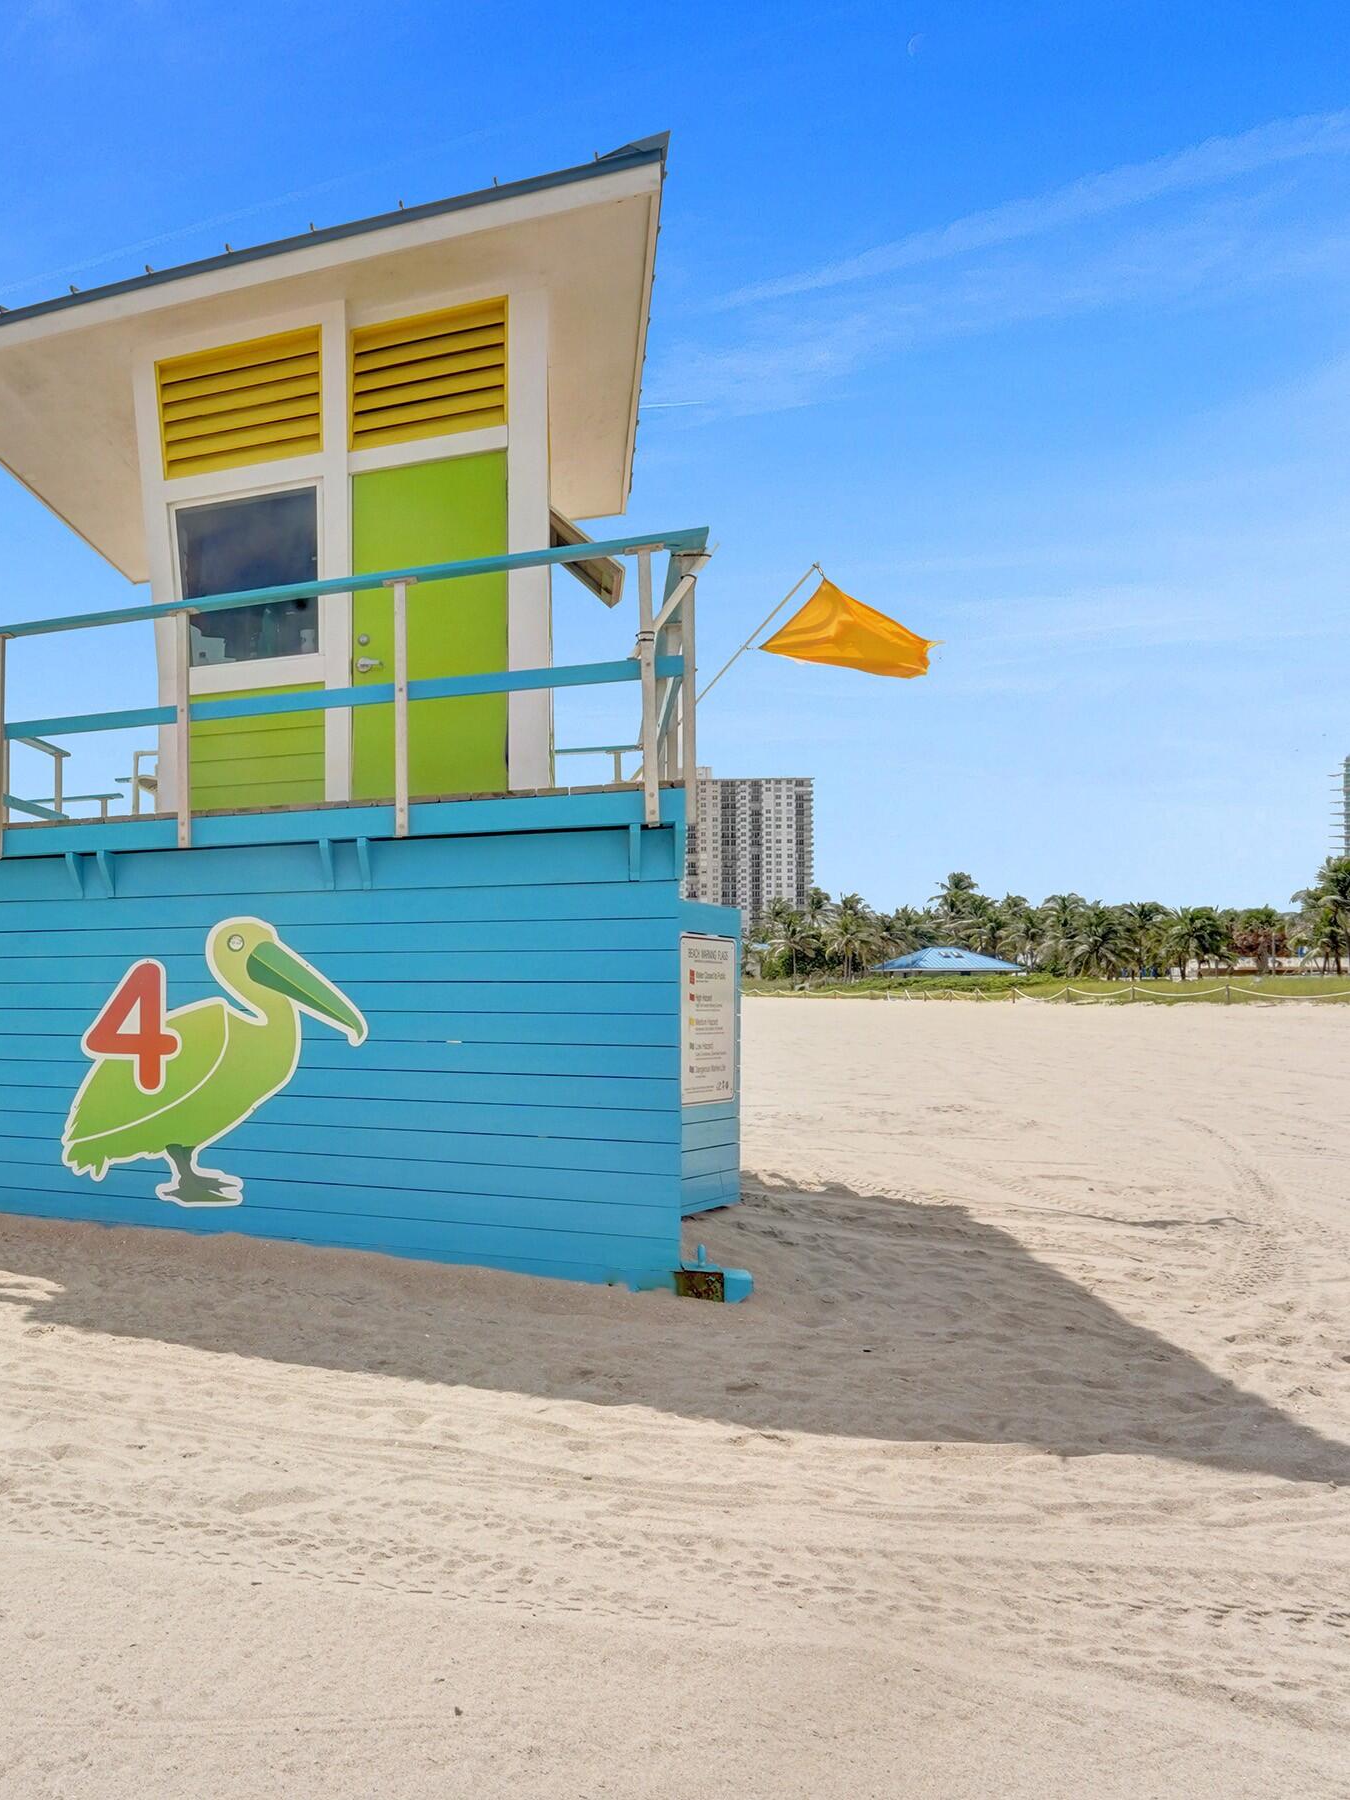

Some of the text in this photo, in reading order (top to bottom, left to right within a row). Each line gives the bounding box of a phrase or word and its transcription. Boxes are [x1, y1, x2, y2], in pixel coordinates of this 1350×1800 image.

[688, 948, 729, 961] BEACH WARNING FLAGS
[85, 962, 178, 1090] 4
